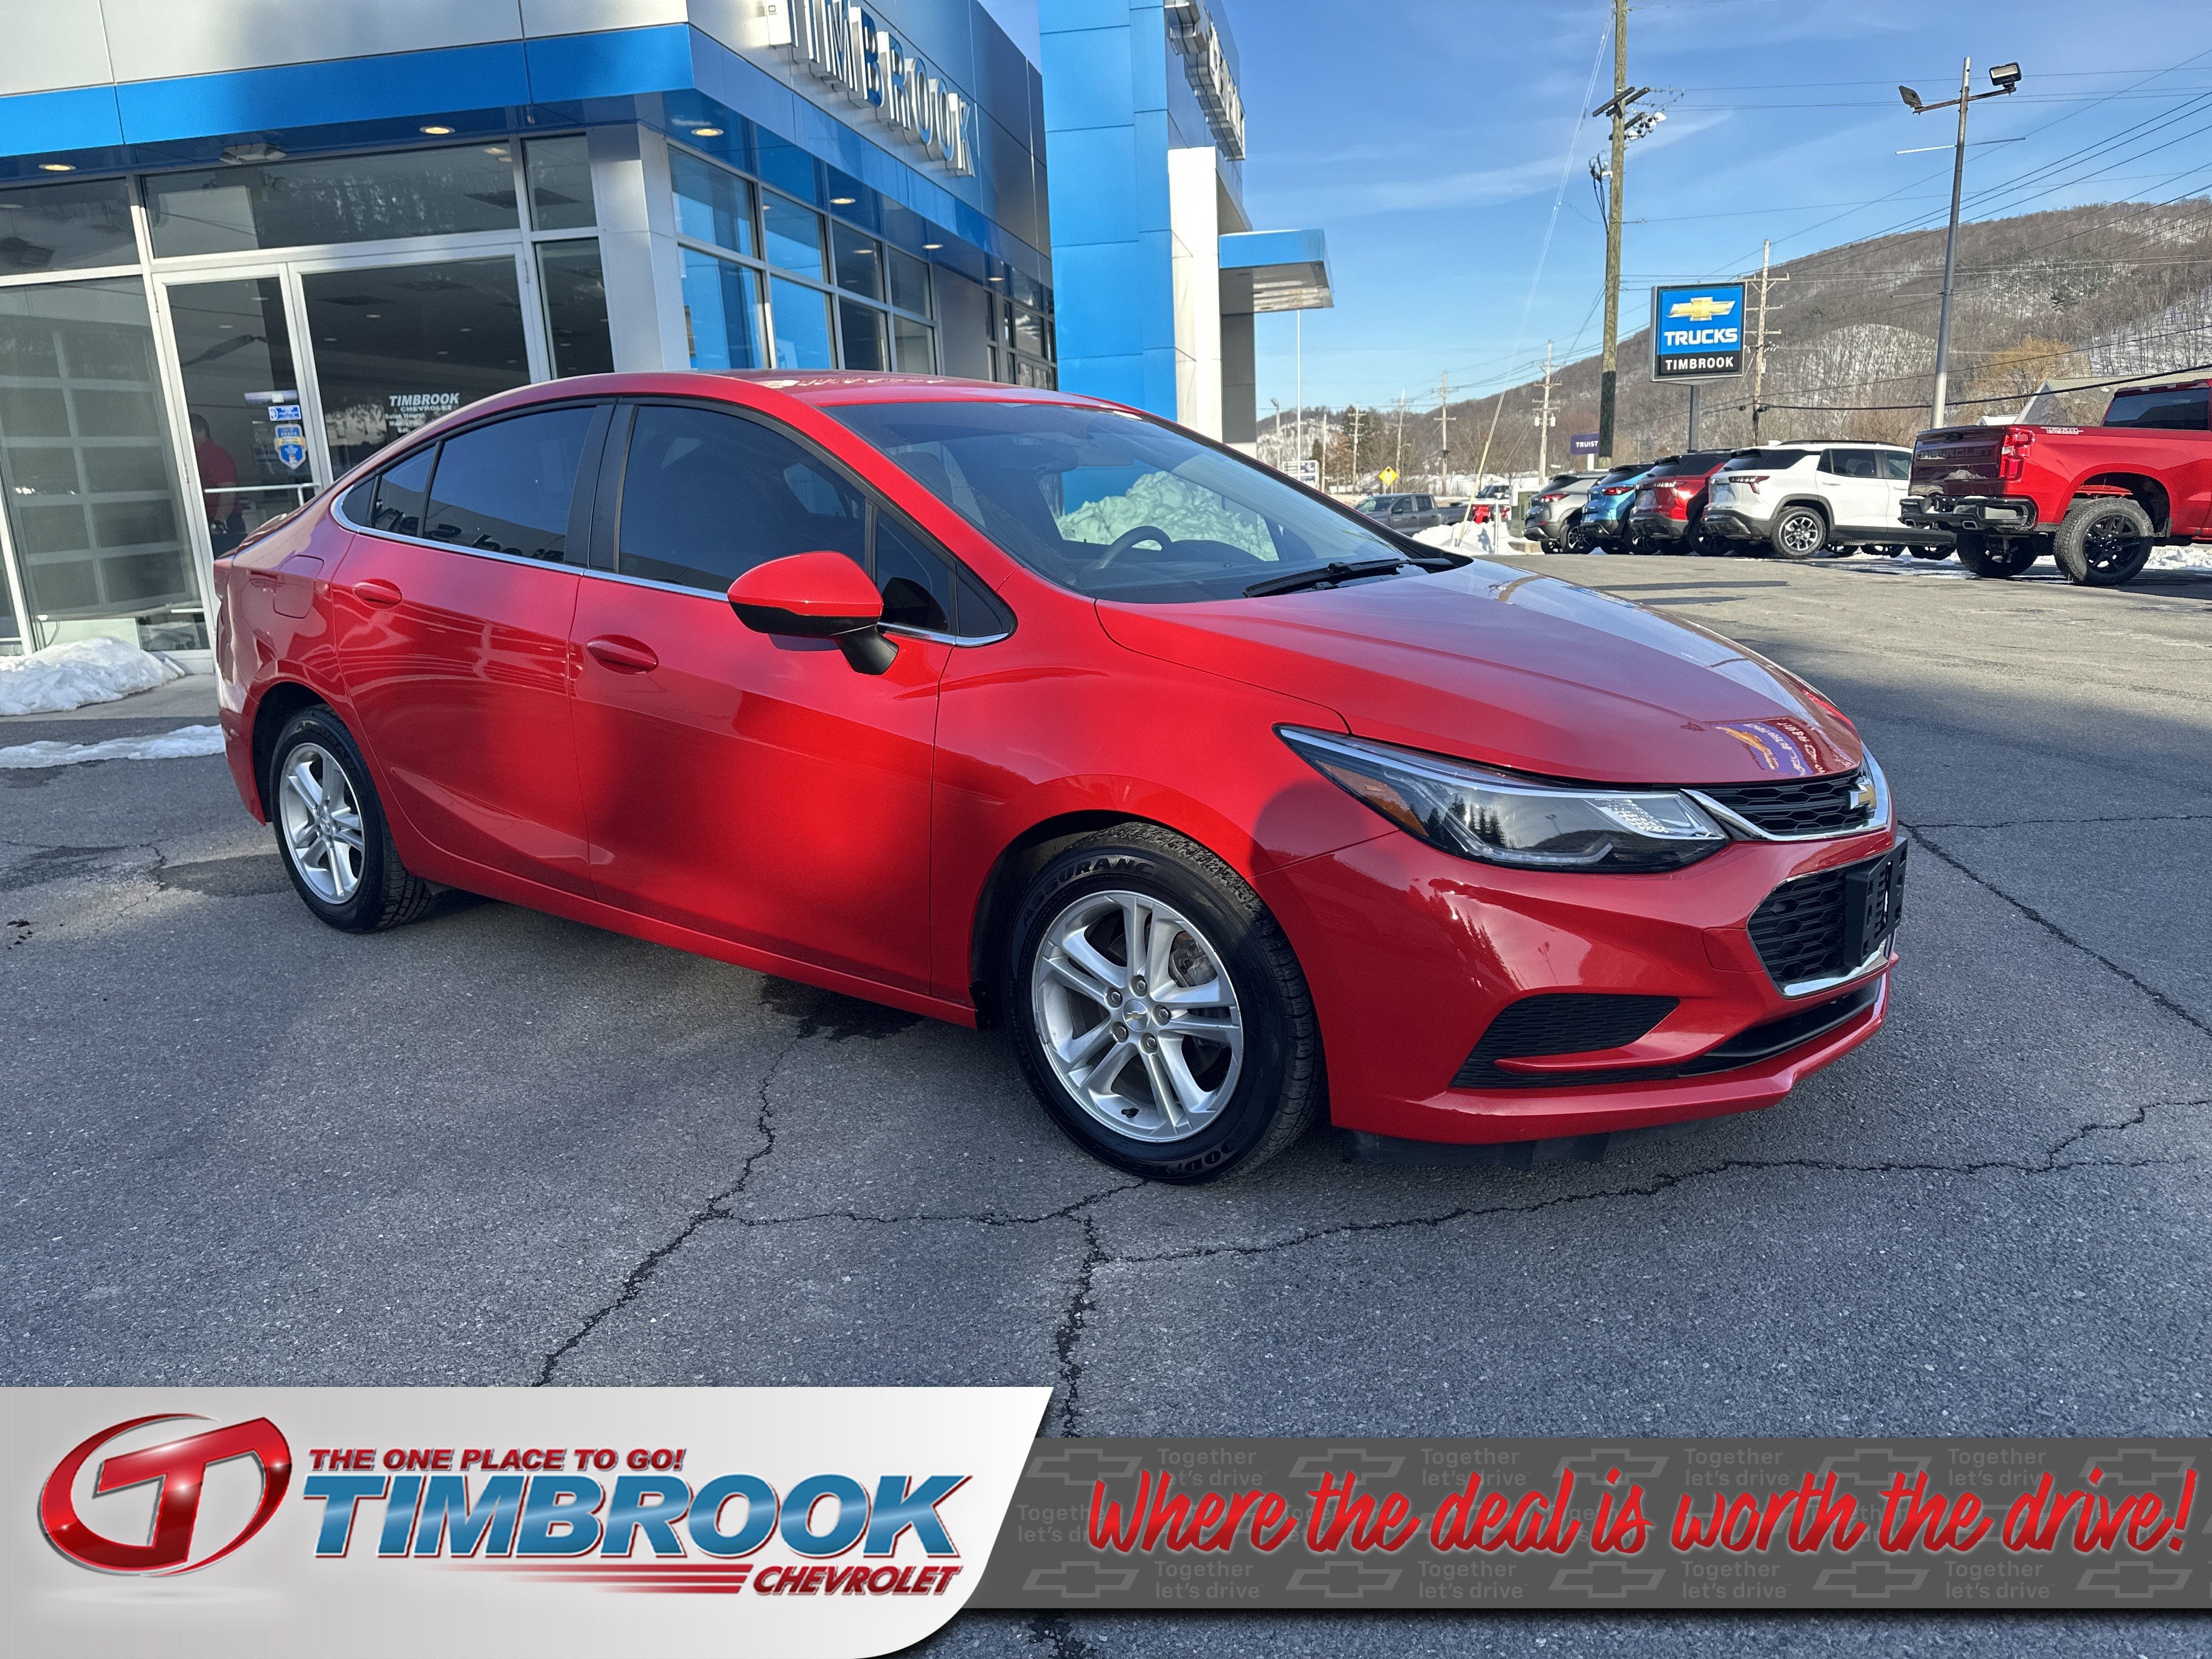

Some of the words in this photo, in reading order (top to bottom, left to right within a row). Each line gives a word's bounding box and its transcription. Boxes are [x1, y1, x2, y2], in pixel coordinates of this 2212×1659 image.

[1664, 328, 1738, 346] TRUCKS
[1665, 356, 1734, 370] TIMBROOK
[389, 392, 460, 407] TIMBROOK
[1916, 447, 1992, 460] CHEVROLET
